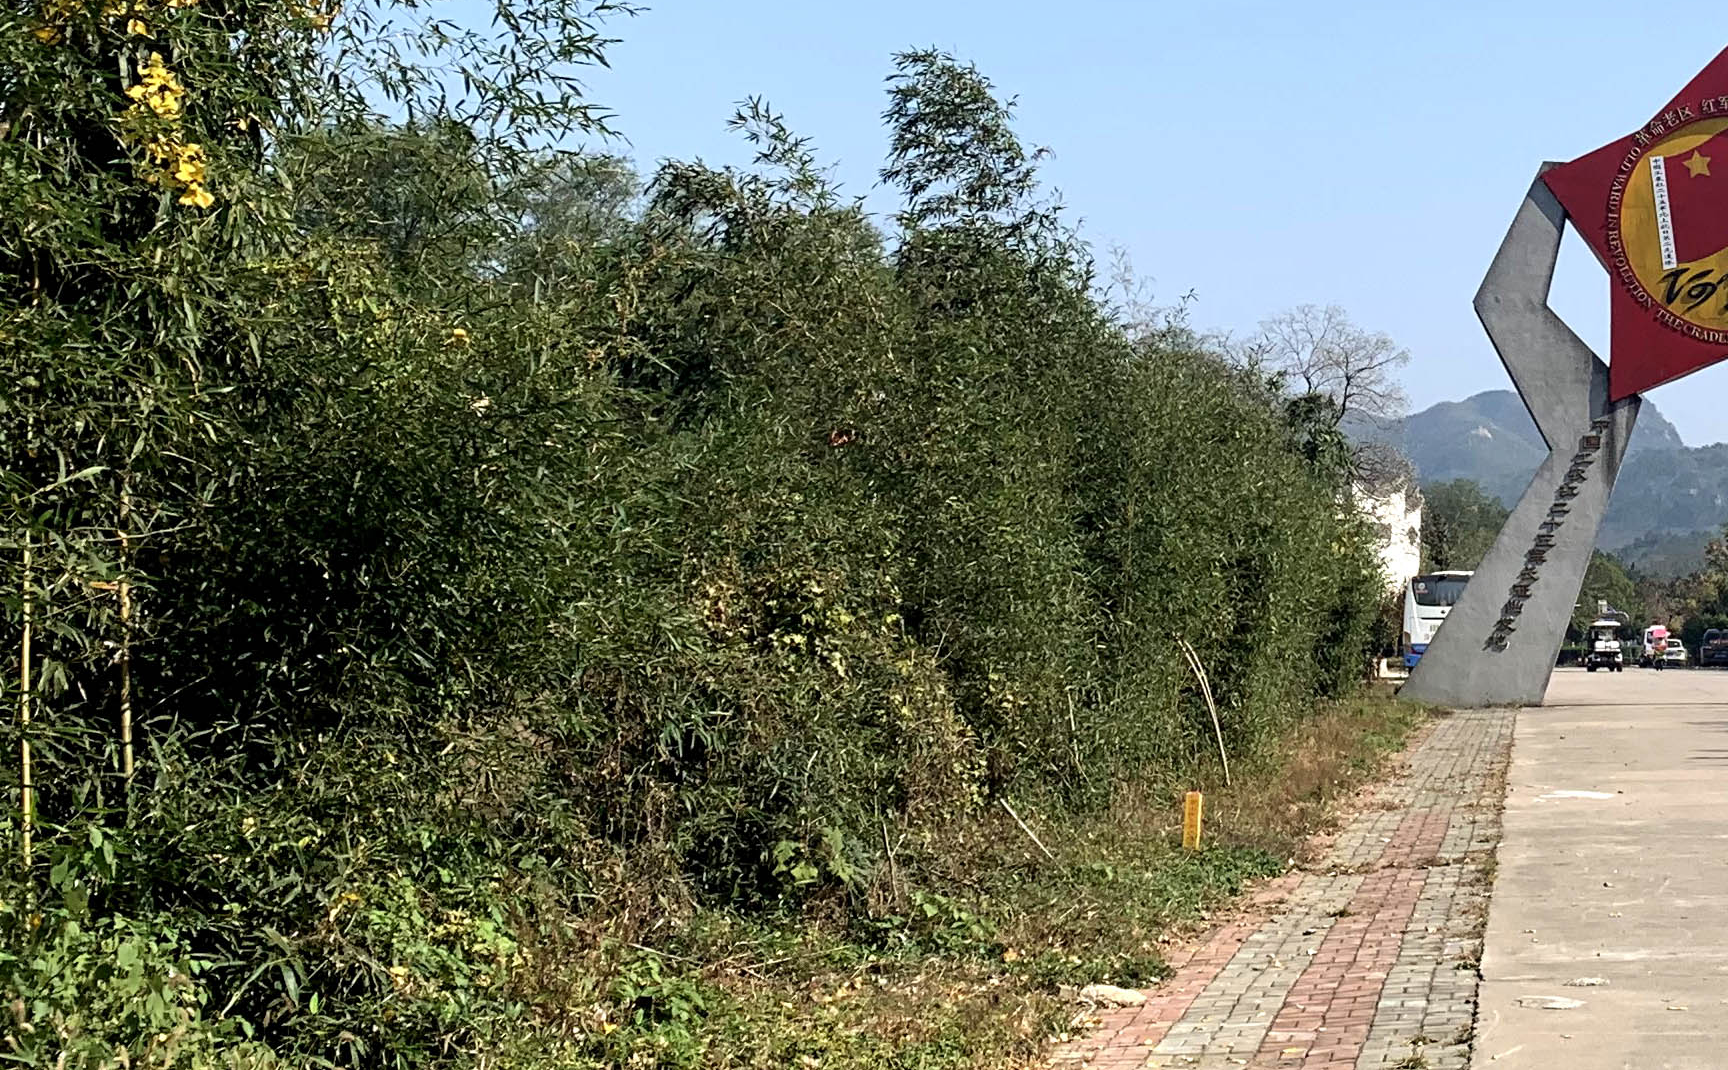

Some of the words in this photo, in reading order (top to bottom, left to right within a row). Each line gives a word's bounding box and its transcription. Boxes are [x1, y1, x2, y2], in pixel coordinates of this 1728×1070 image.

[1634, 106, 1695, 147] 革命老区
[1620, 146, 1641, 172] OLD
[1609, 174, 1627, 210] WARD
[1608, 230, 1655, 308] REVOLUTION
[1656, 308, 1684, 328] THE
